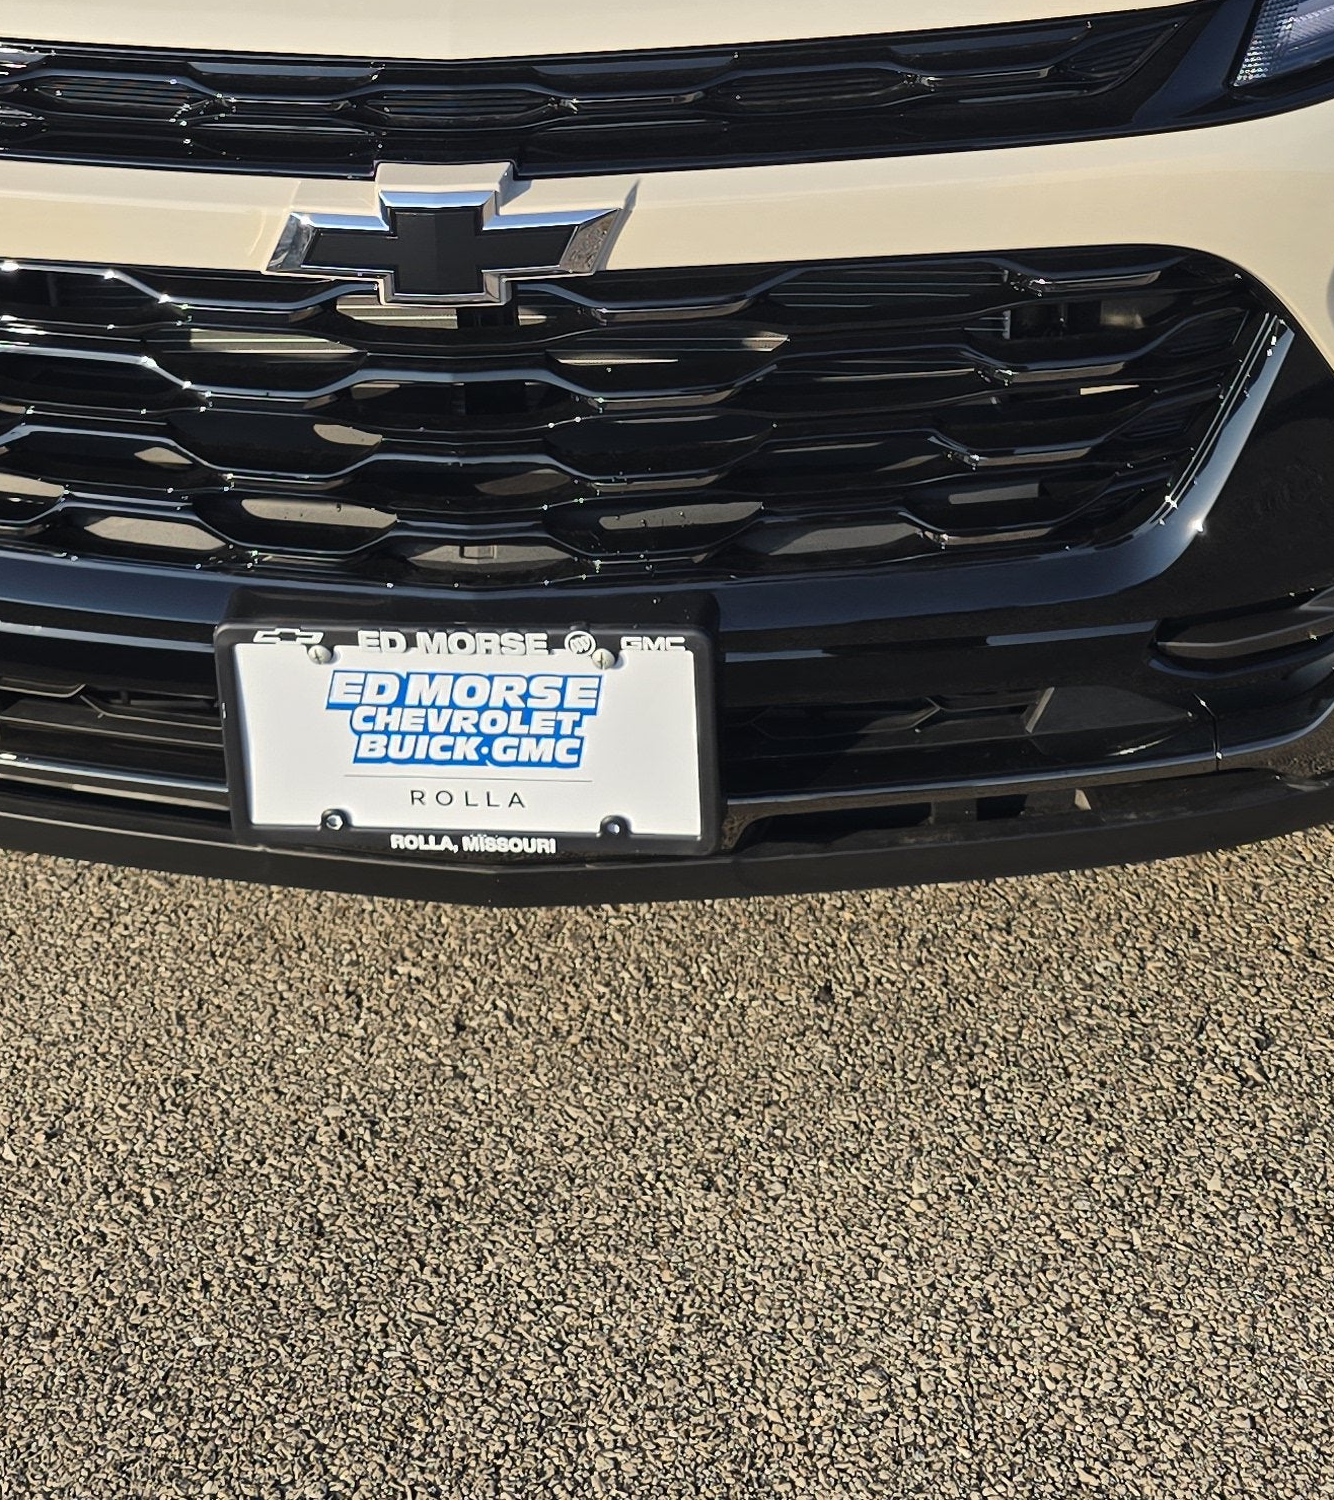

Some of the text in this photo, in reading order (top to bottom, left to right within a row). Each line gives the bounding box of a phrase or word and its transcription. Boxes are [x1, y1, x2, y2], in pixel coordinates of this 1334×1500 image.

[358, 630, 549, 656] ED MORSE
[620, 636, 686, 651] GMC
[330, 671, 599, 709] ED MORSE
[351, 705, 582, 736] CHEVROLET
[410, 789, 526, 809] ROLLA
[390, 833, 556, 854] ROLLA, MISSOURI
